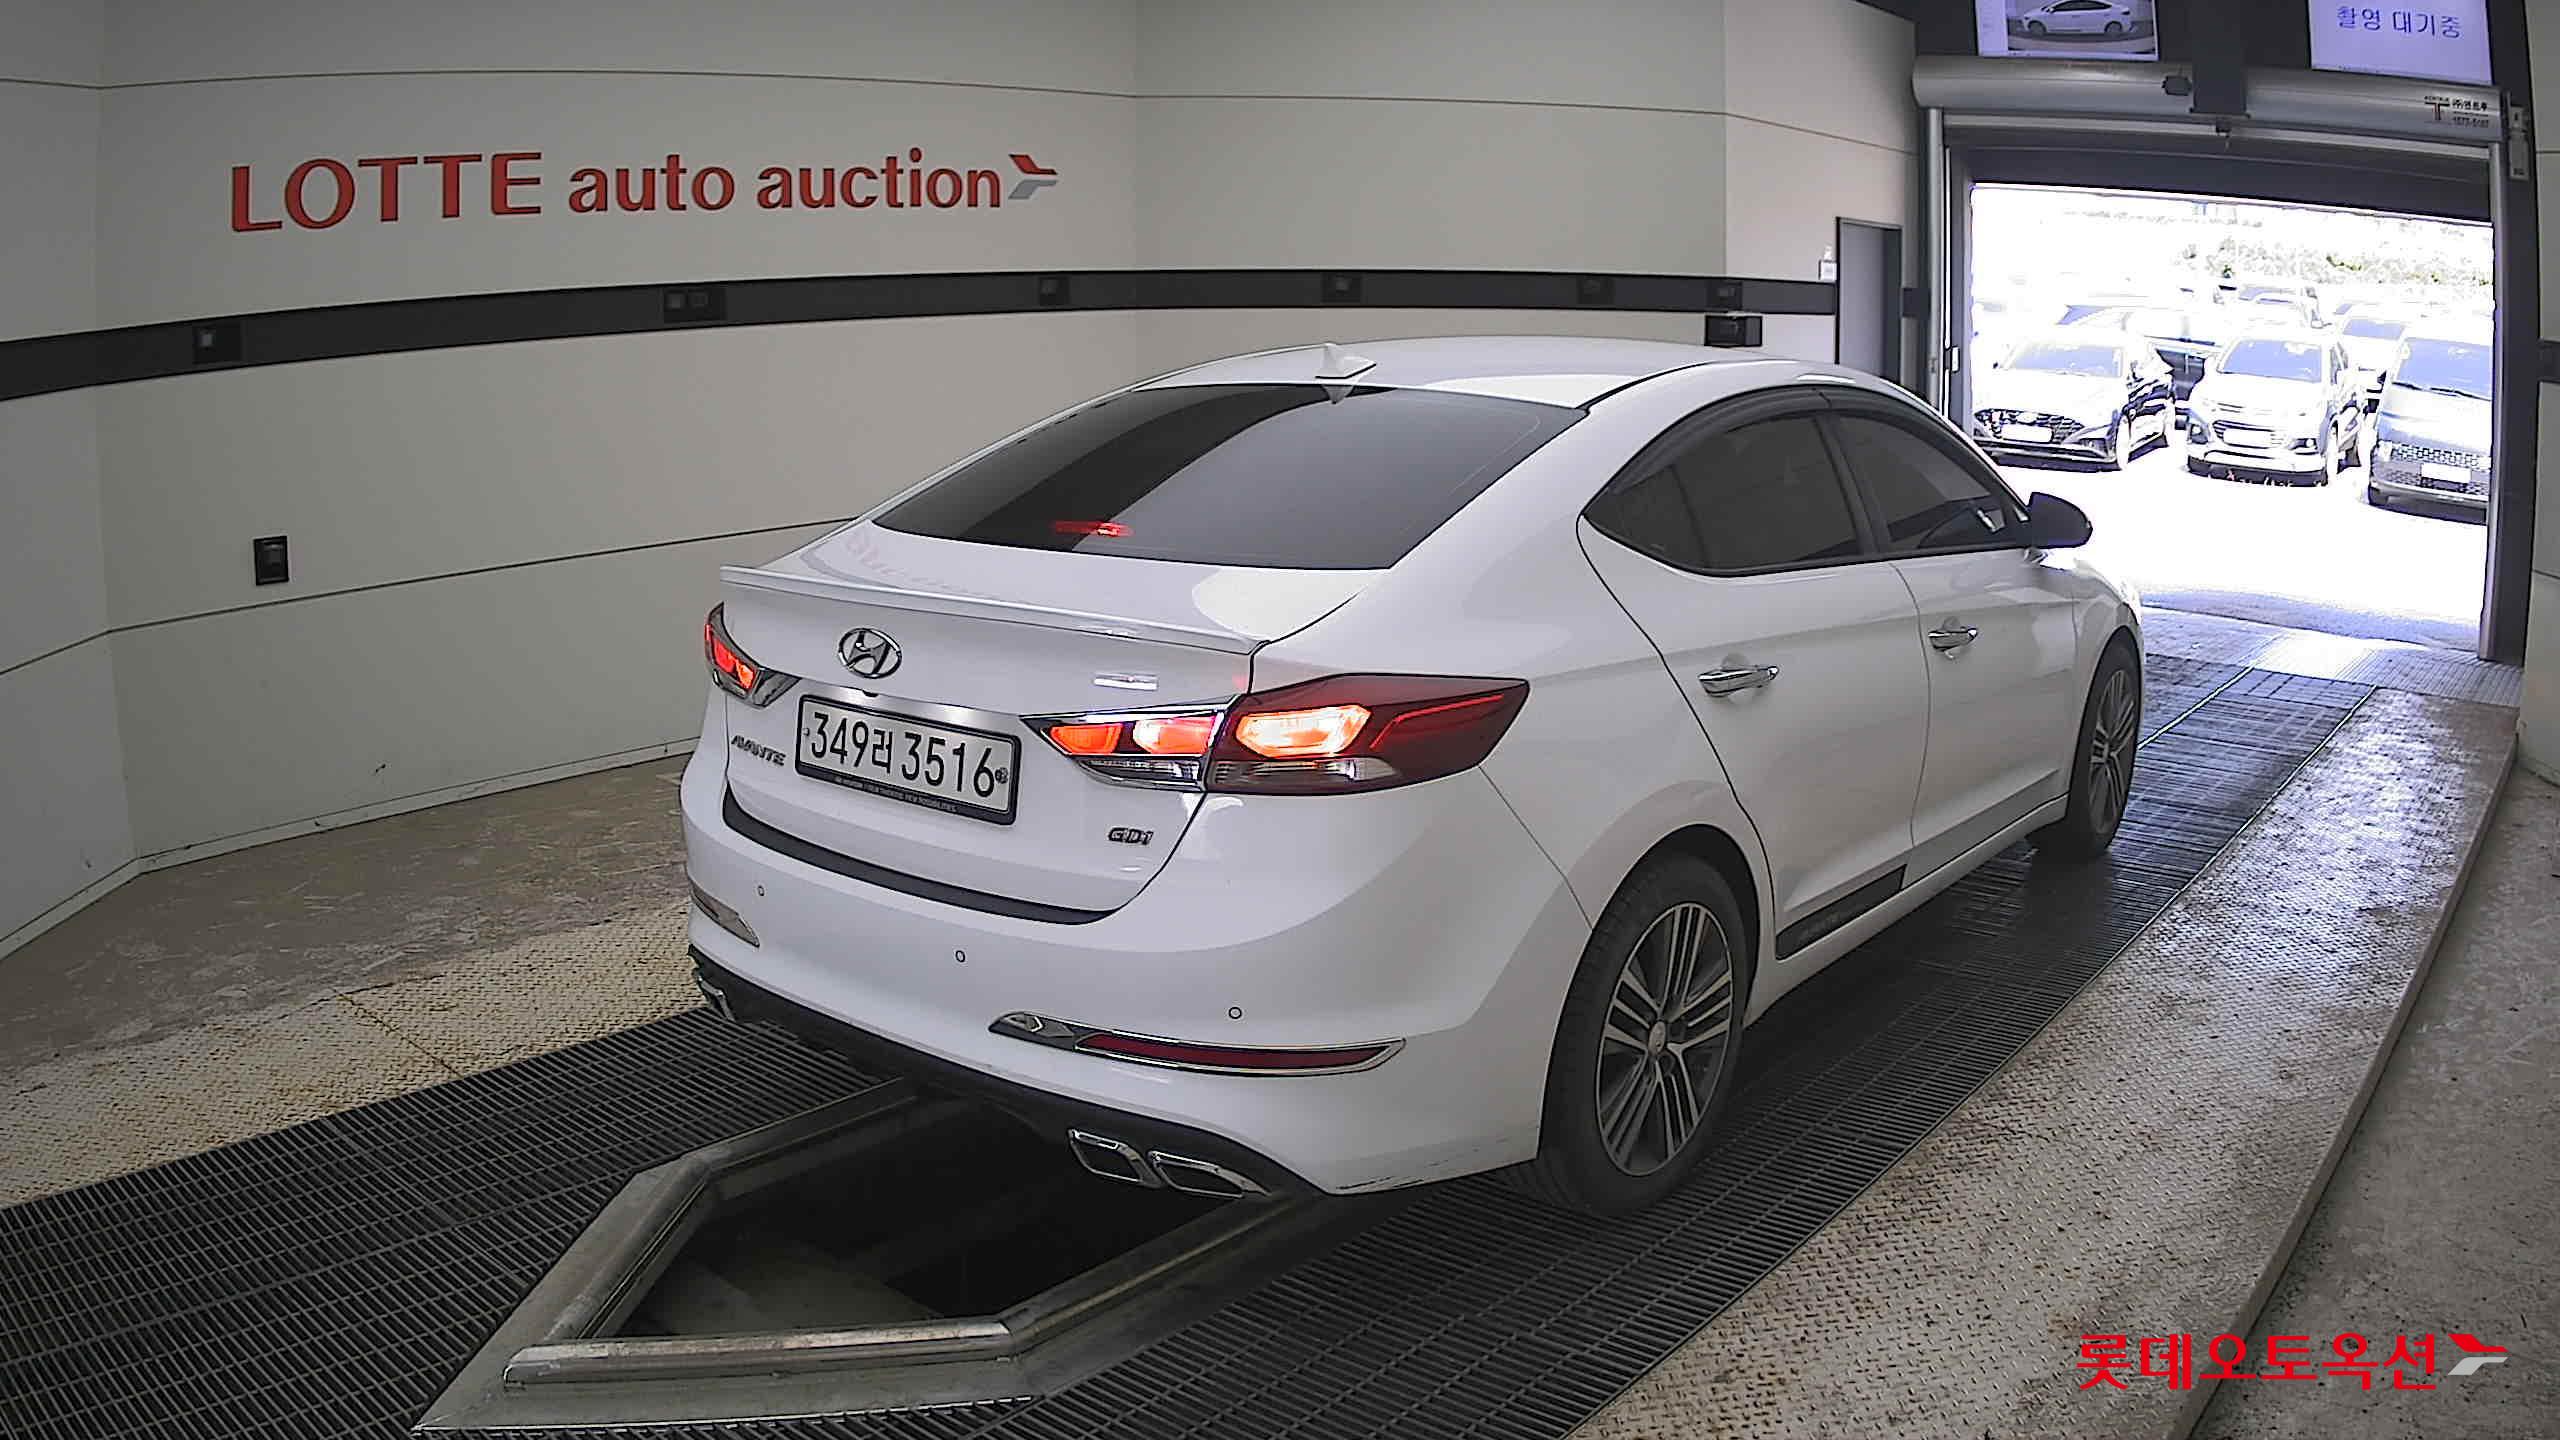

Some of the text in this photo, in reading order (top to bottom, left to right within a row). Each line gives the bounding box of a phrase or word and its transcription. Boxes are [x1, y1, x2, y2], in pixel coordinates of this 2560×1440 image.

[2336, 6, 2460, 39] 촬영 대기중
[231, 148, 1001, 232] LOTTE auto auction
[731, 735, 786, 766] AVANTE
[811, 711, 995, 798] 349러 3516
